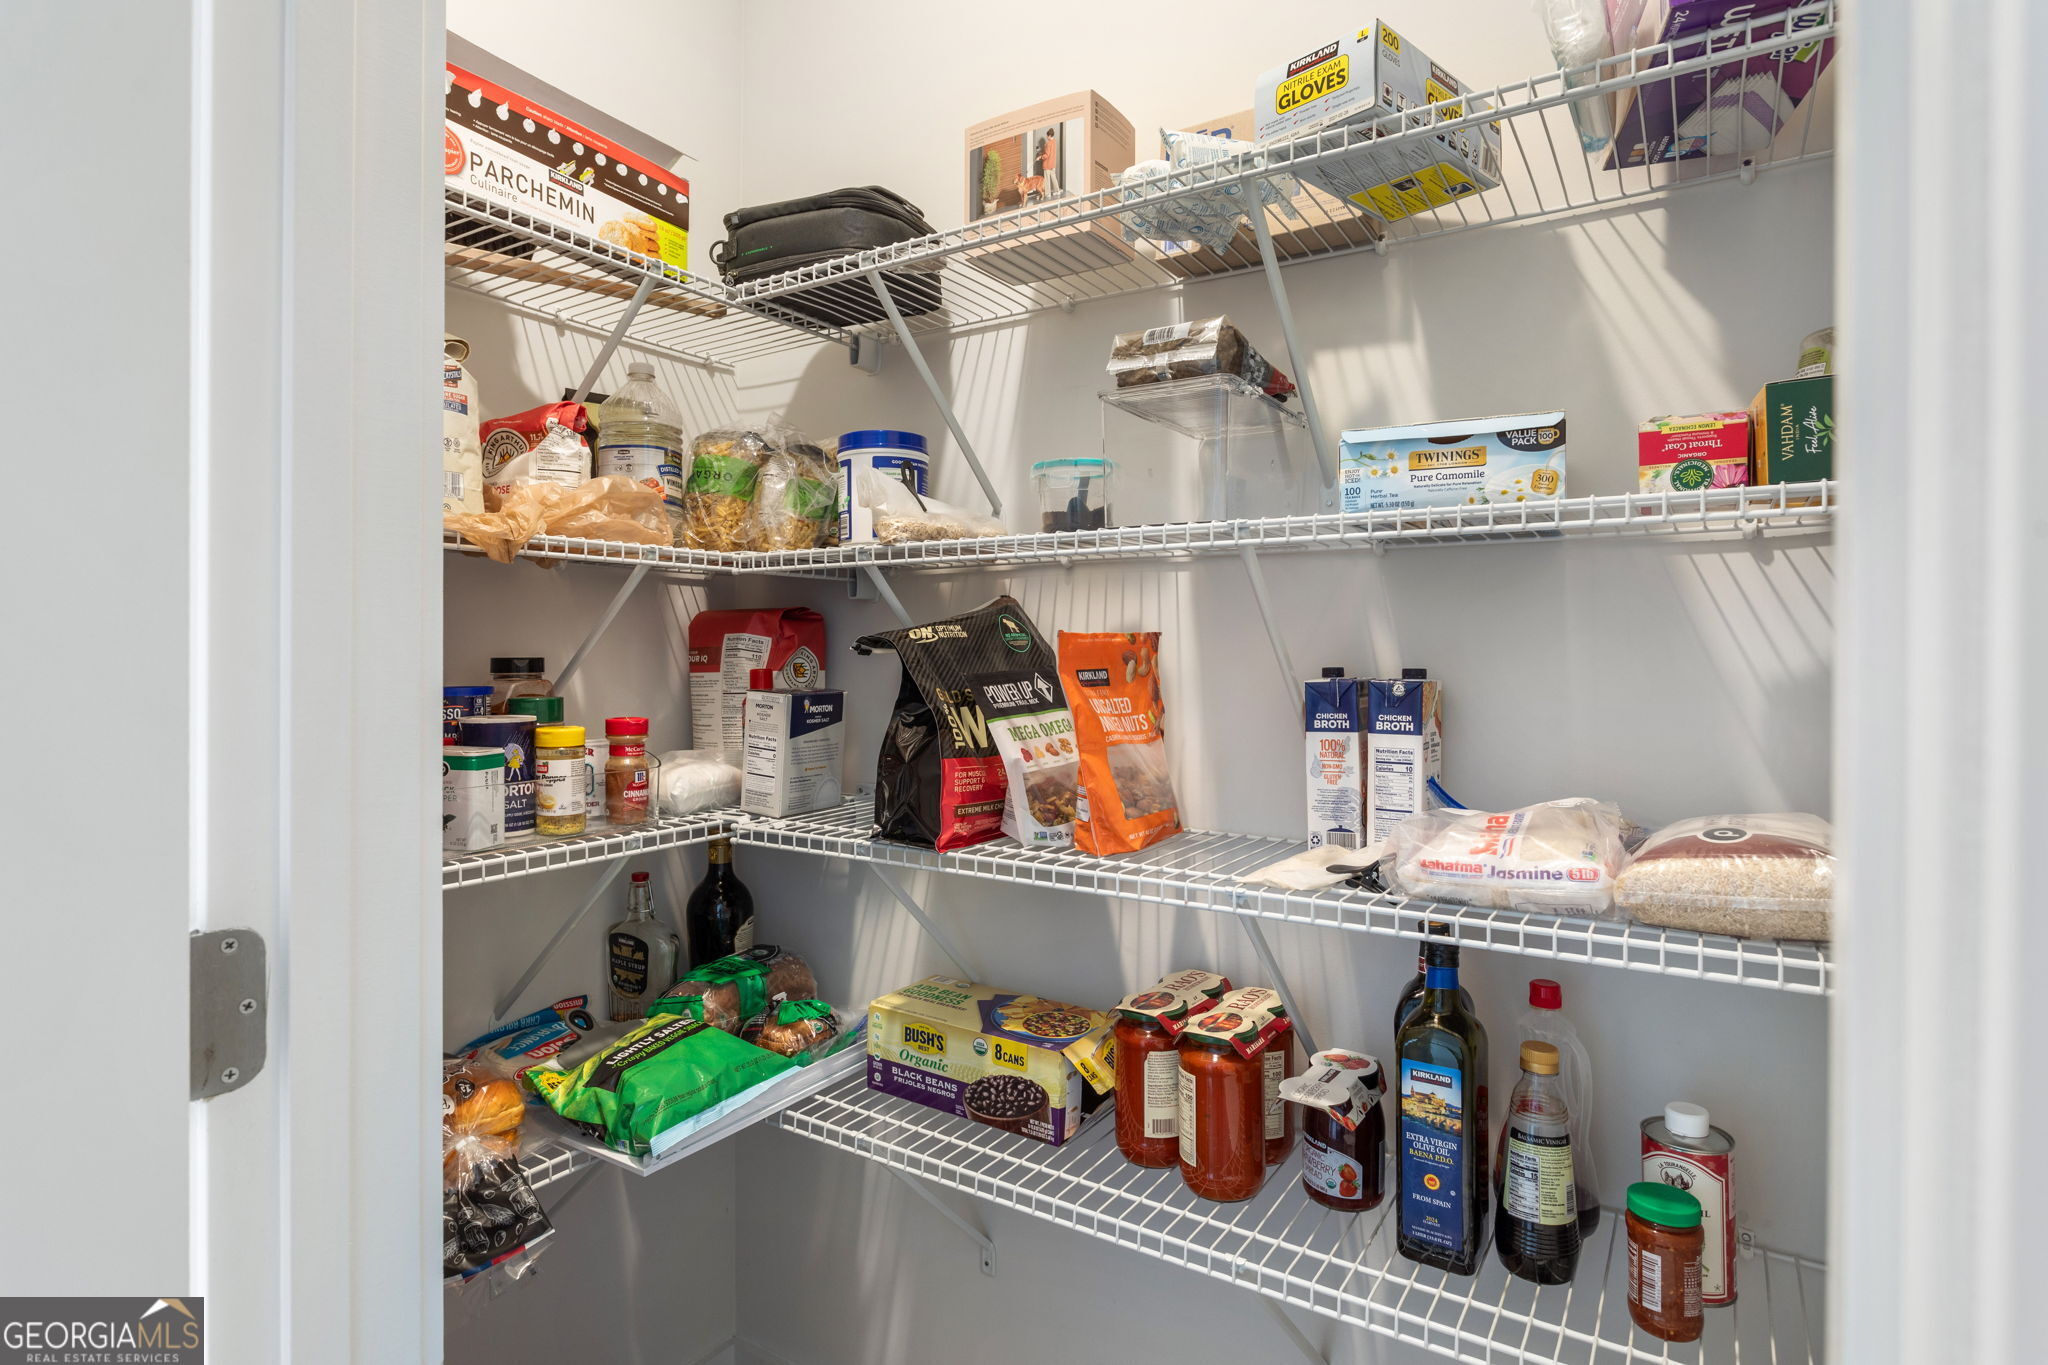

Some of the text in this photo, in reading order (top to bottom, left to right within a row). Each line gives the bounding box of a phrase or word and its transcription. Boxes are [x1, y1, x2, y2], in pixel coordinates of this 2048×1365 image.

[1672, 10, 1690, 24] 24
[1382, 28, 1399, 50] 200
[1290, 44, 1337, 71] KIRKLAND
[1284, 60, 1341, 92] NITRILE EXAM
[1278, 68, 1346, 110] GLOVES
[470, 152, 595, 224] PARCHEMIN
[550, 170, 584, 192] KIRKLAND
[470, 175, 518, 204] Culinaire
[1506, 429, 1537, 438] VALUE
[1782, 404, 1792, 461] VAHDAM
[1802, 406, 1821, 454] Feel Alive
[488, 438, 500, 456] KING
[1512, 437, 1537, 446] PACK
[1664, 440, 1724, 450] Throat Coat
[1416, 449, 1480, 464] TWININGS
[1674, 460, 1710, 474] MEDICINALS
[696, 470, 732, 481] ORGA
[1410, 470, 1486, 482] Pure Camomile
[1536, 474, 1554, 483] 300
[1344, 487, 1360, 496] 100
[908, 626, 934, 640] ON
[700, 655, 708, 664] IQ
[1078, 670, 1108, 680] KIRKLAND
[983, 683, 1022, 704] POWER
[1018, 680, 1033, 700] UP
[810, 704, 834, 713] MORTON
[992, 700, 1016, 709] PREMIUM
[1008, 718, 1074, 742] MEGA OMEGA
[1314, 720, 1350, 728] BROTH
[1376, 722, 1414, 732] BROTH
[1320, 739, 1346, 752] 100%
[505, 782, 535, 797] ORTON
[954, 778, 980, 786] SUPPORT
[505, 800, 528, 809] SALT
[958, 806, 982, 815] EXTREME
[982, 804, 994, 812] MILK
[1488, 865, 1563, 880] Jasmine
[1162, 970, 1207, 992] RAO'S
[903, 988, 965, 1006] GOODNESS
[914, 984, 972, 1000] ADD BEAN
[1228, 988, 1268, 1010] RAO'S
[552, 998, 584, 1010] mission
[520, 1016, 540, 1028] CARB
[904, 1026, 944, 1052] BUSH'S
[606, 1036, 656, 1066] LIGHTLY
[616, 1030, 688, 1068] Crispy BAKED VEGGIE
[994, 1044, 1025, 1067] 8 CANS
[899, 1048, 949, 1072] Organic
[1104, 1044, 1114, 1070] BUS
[1080, 1062, 1090, 1074] 8
[892, 1066, 958, 1092] BLACK BEANS
[1412, 1070, 1452, 1084] KIRKLAND
[458, 1084, 472, 1093] 12
[894, 1076, 956, 1100] FRIJOLES NEGROS
[1406, 1132, 1458, 1151] EXTRA VIRGIN
[1518, 1132, 1545, 1145] BALSAMIC
[1413, 1141, 1450, 1156] OLIVE OIL
[1410, 1148, 1454, 1165] BAENA P.D.O.
[1304, 1156, 1338, 1176] AWBERRY
[1663, 1161, 1697, 1180] TOURANGELLE
[1412, 1192, 1452, 1209] FROM SPAIN
[1426, 1216, 1438, 1224] 2024
